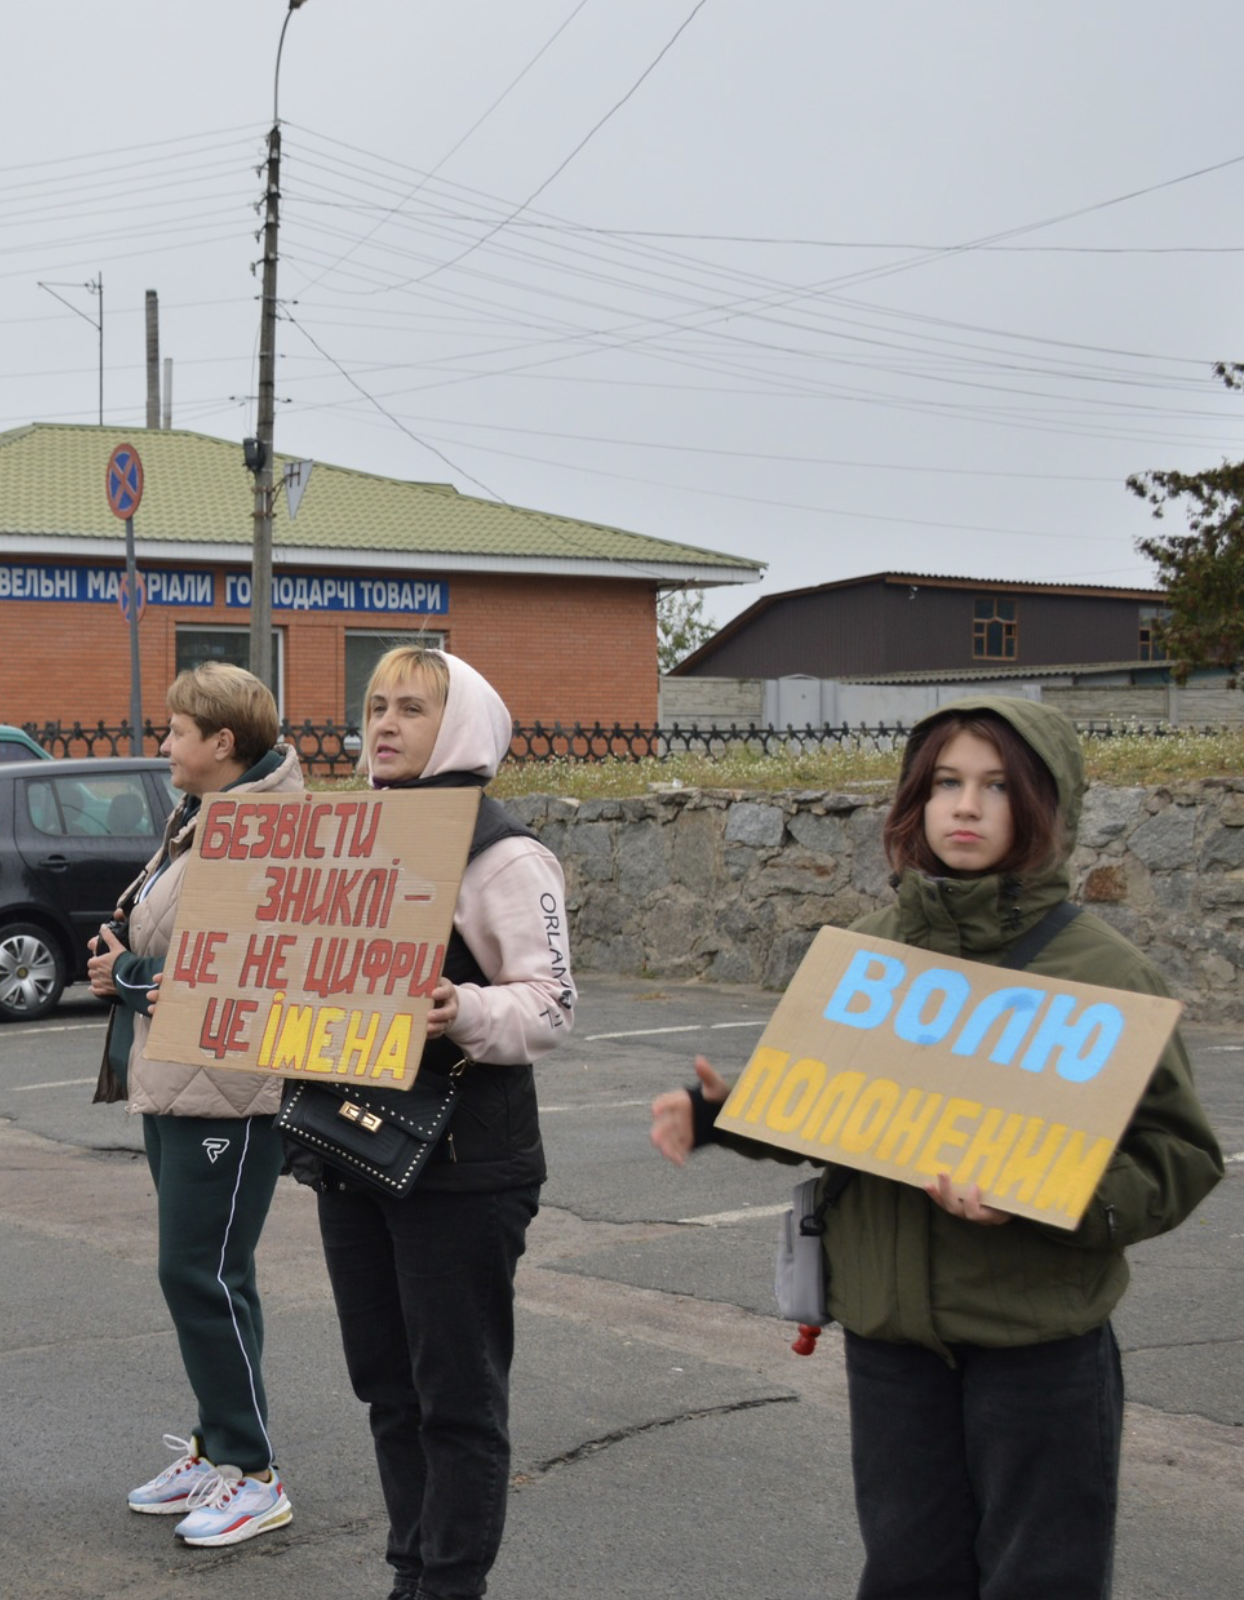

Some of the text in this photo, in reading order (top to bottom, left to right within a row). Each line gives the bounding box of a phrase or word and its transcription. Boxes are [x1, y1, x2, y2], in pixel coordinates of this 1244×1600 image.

[87, 570, 212, 603] МАРІАЛИ
[225, 575, 441, 611] ГОПОДАРЧІ ТОВАРИ
[199, 794, 383, 860] БЕЗВІСТИ
[173, 931, 445, 998] ЦЕ НЕ ЦИФРИ
[199, 991, 414, 1080] ЦЕ ІМЕНА
[822, 949, 1125, 1084] ВОЛЮ
[724, 1046, 1114, 1218] ПОЛОНЕНИМ
